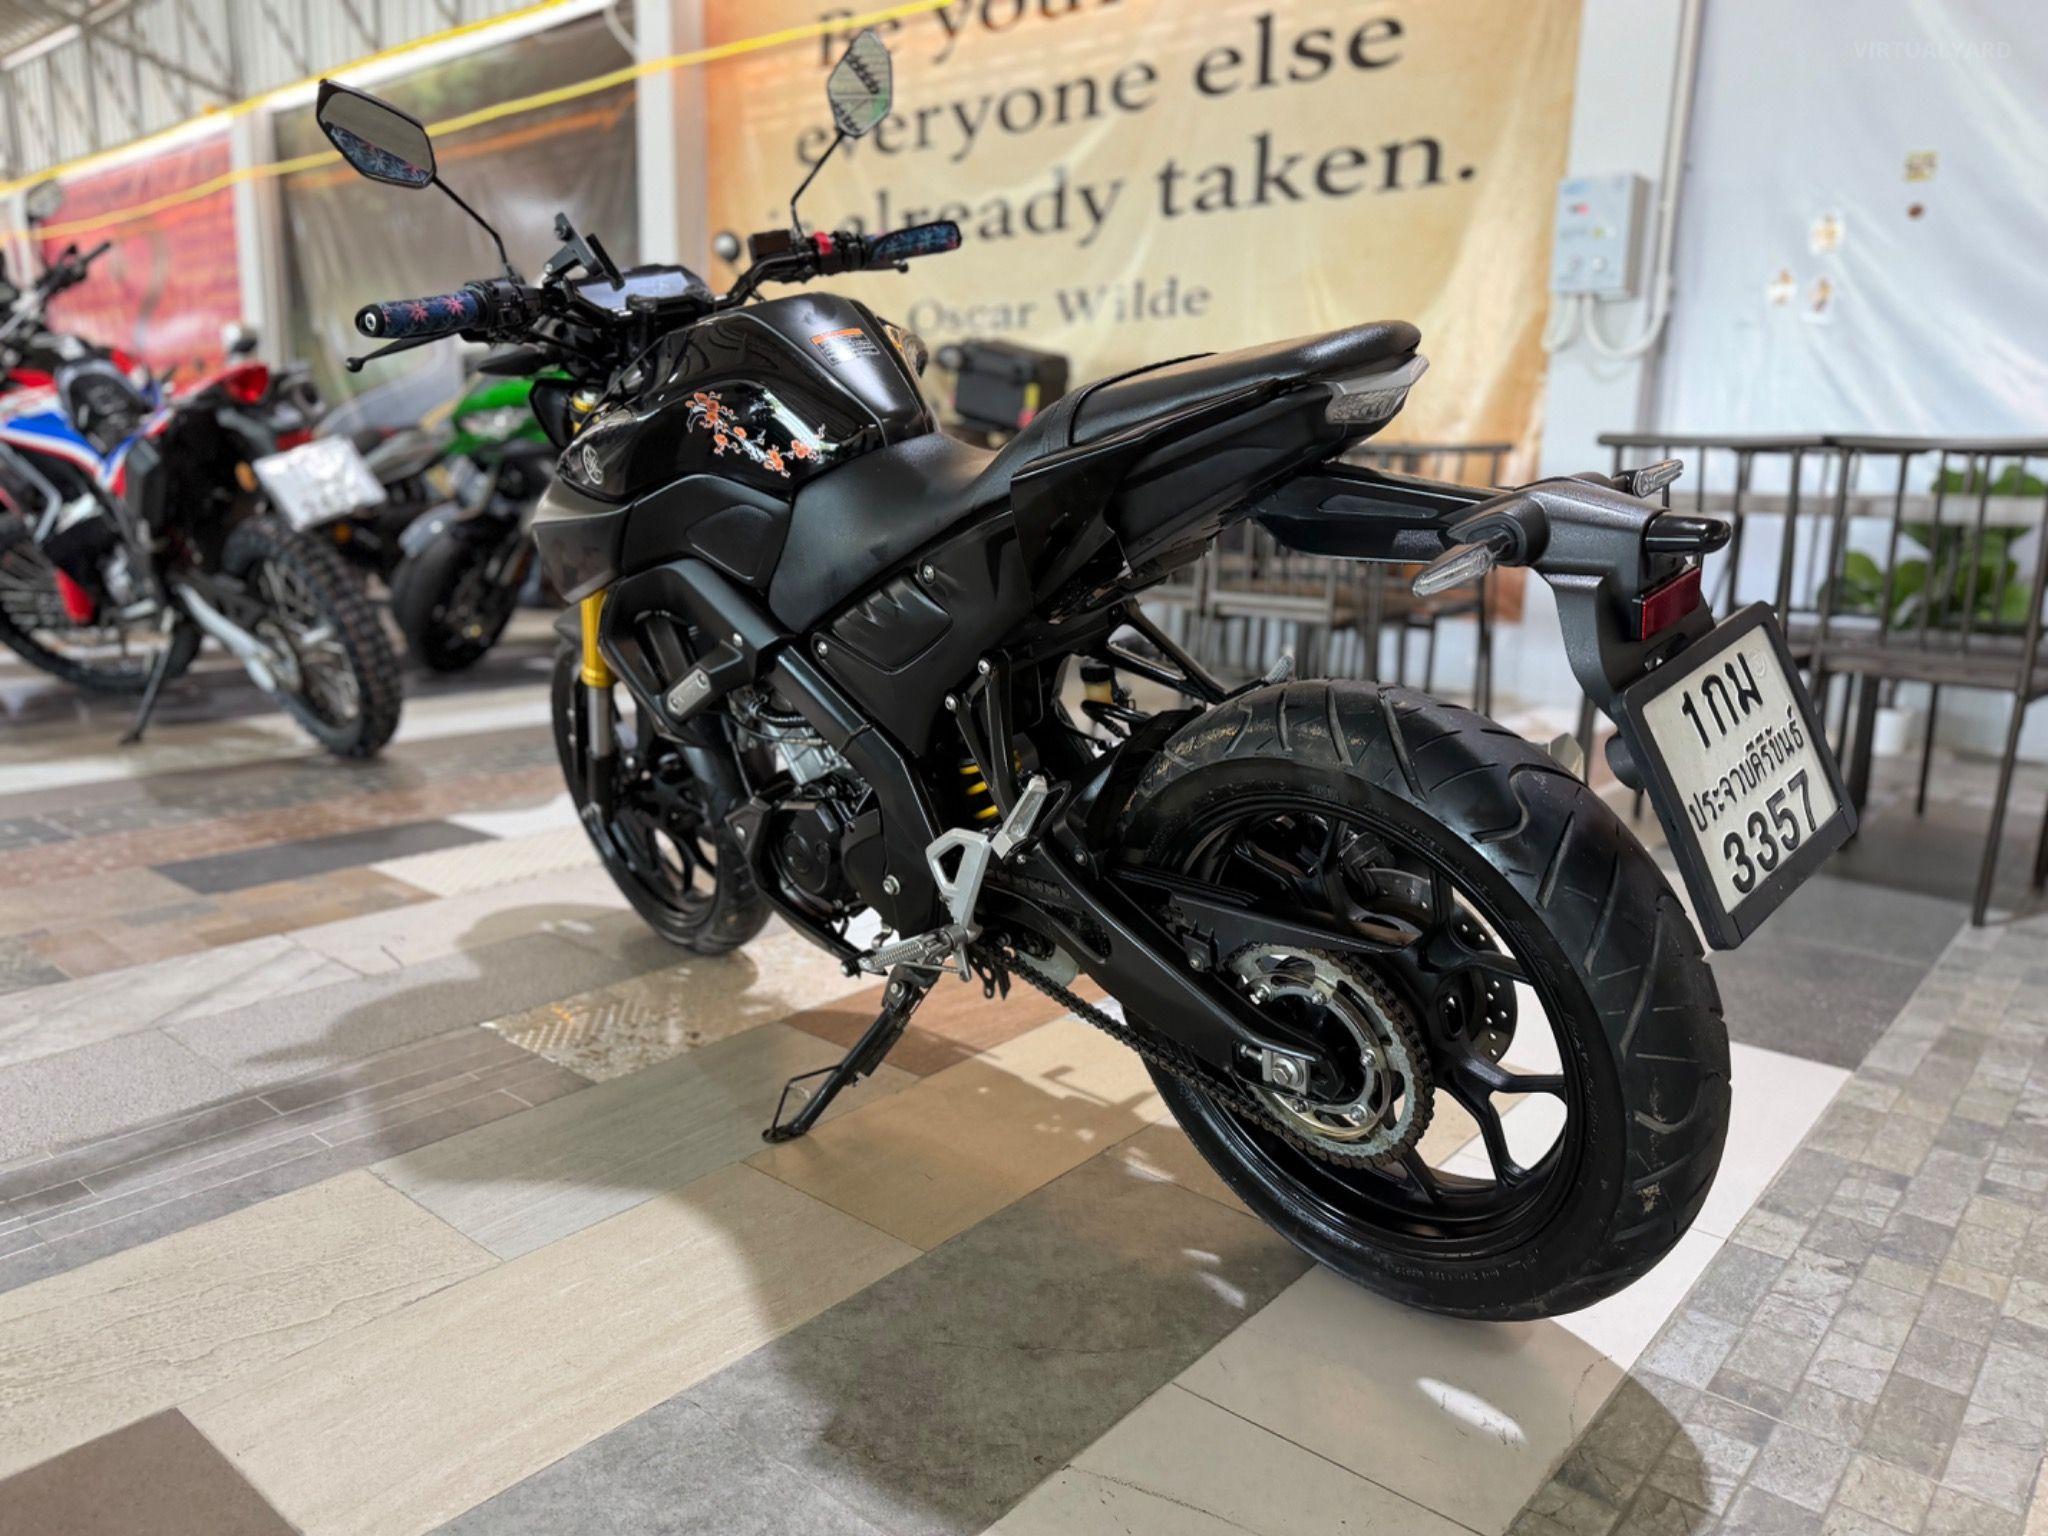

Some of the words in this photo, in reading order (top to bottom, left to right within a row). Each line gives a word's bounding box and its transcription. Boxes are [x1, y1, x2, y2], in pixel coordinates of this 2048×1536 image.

[931, 0, 1121, 66] yo
[796, 60, 1158, 168] eeryone
[1193, 10, 1405, 98] else
[1157, 129, 1477, 218] taken.
[907, 300, 1036, 337] Oscar
[1054, 275, 1211, 325] Wilde
[1681, 652, 1764, 749] 1กม
[1688, 704, 1805, 833] ประจวบคีรีขันธ์
[1723, 768, 1817, 894] 3357
